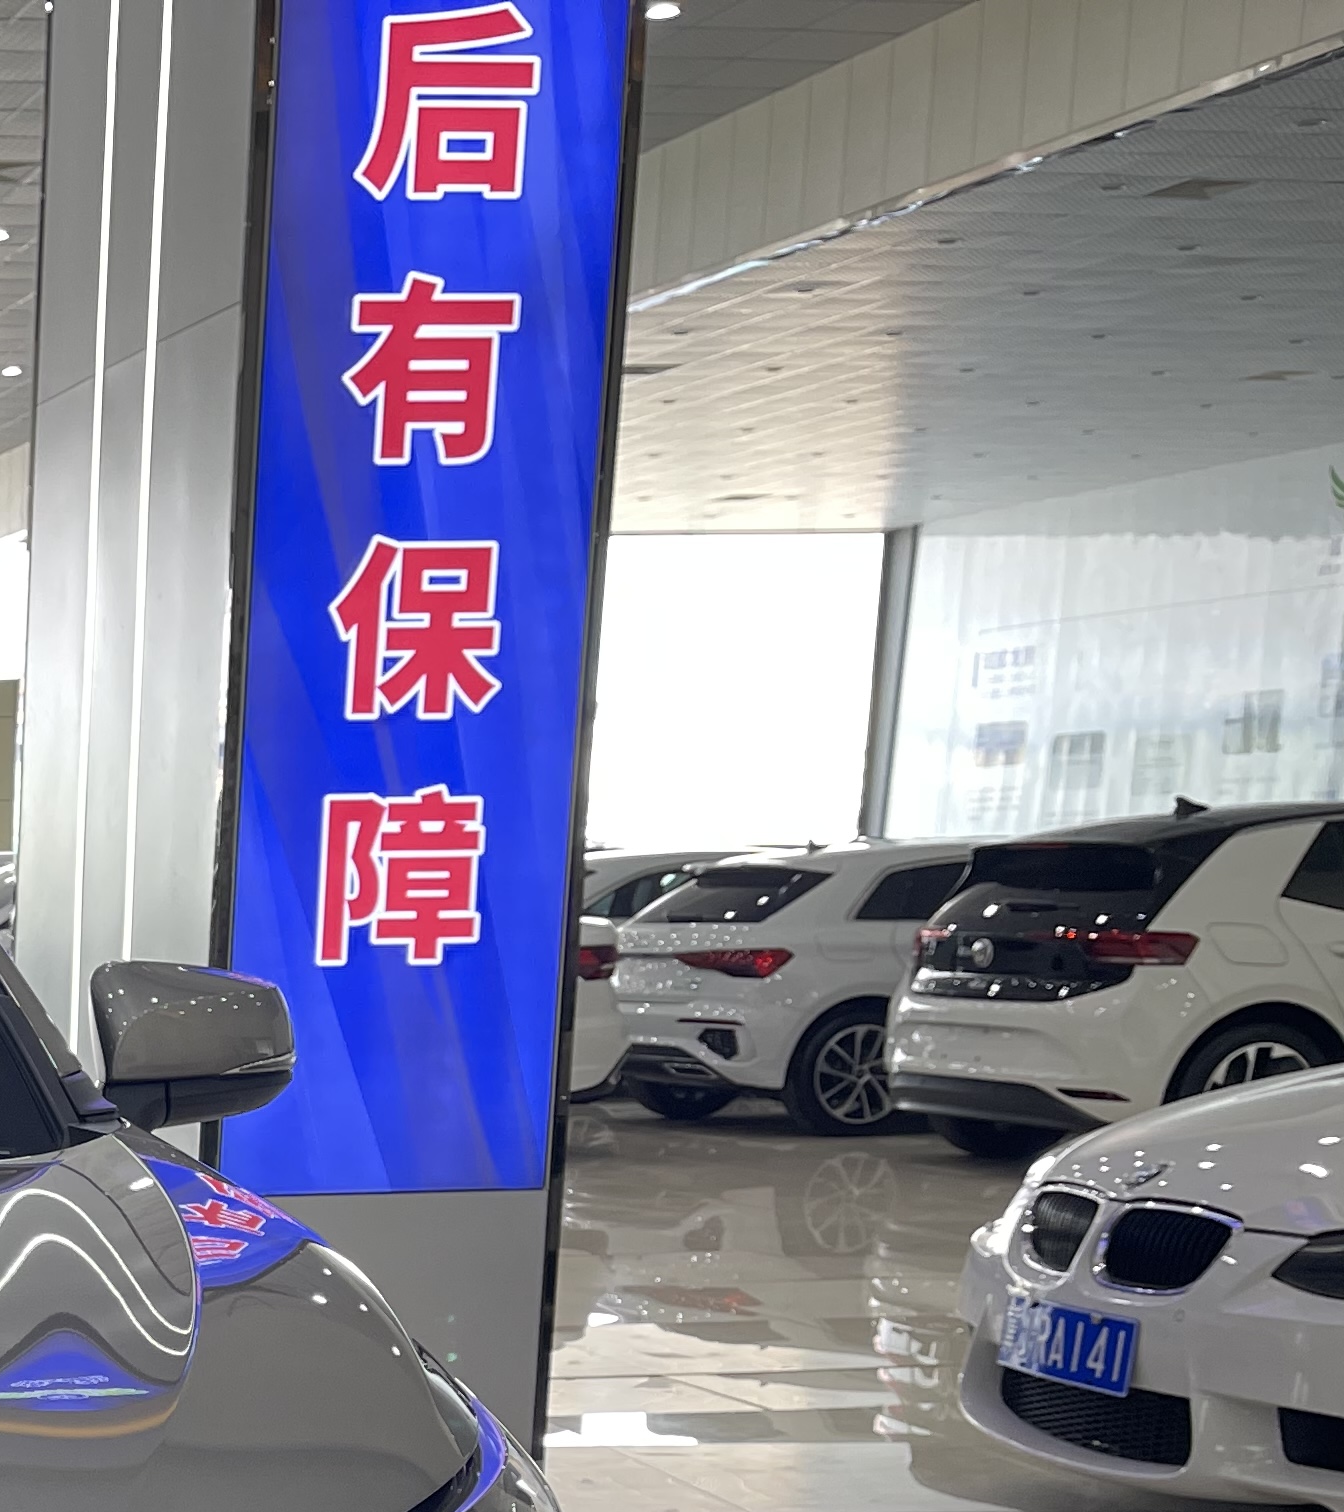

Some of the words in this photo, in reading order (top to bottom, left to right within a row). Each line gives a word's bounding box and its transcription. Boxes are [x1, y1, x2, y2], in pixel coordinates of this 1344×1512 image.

[316, 2, 541, 966] 后有保障
[1002, 1298, 1127, 1382] RA141
